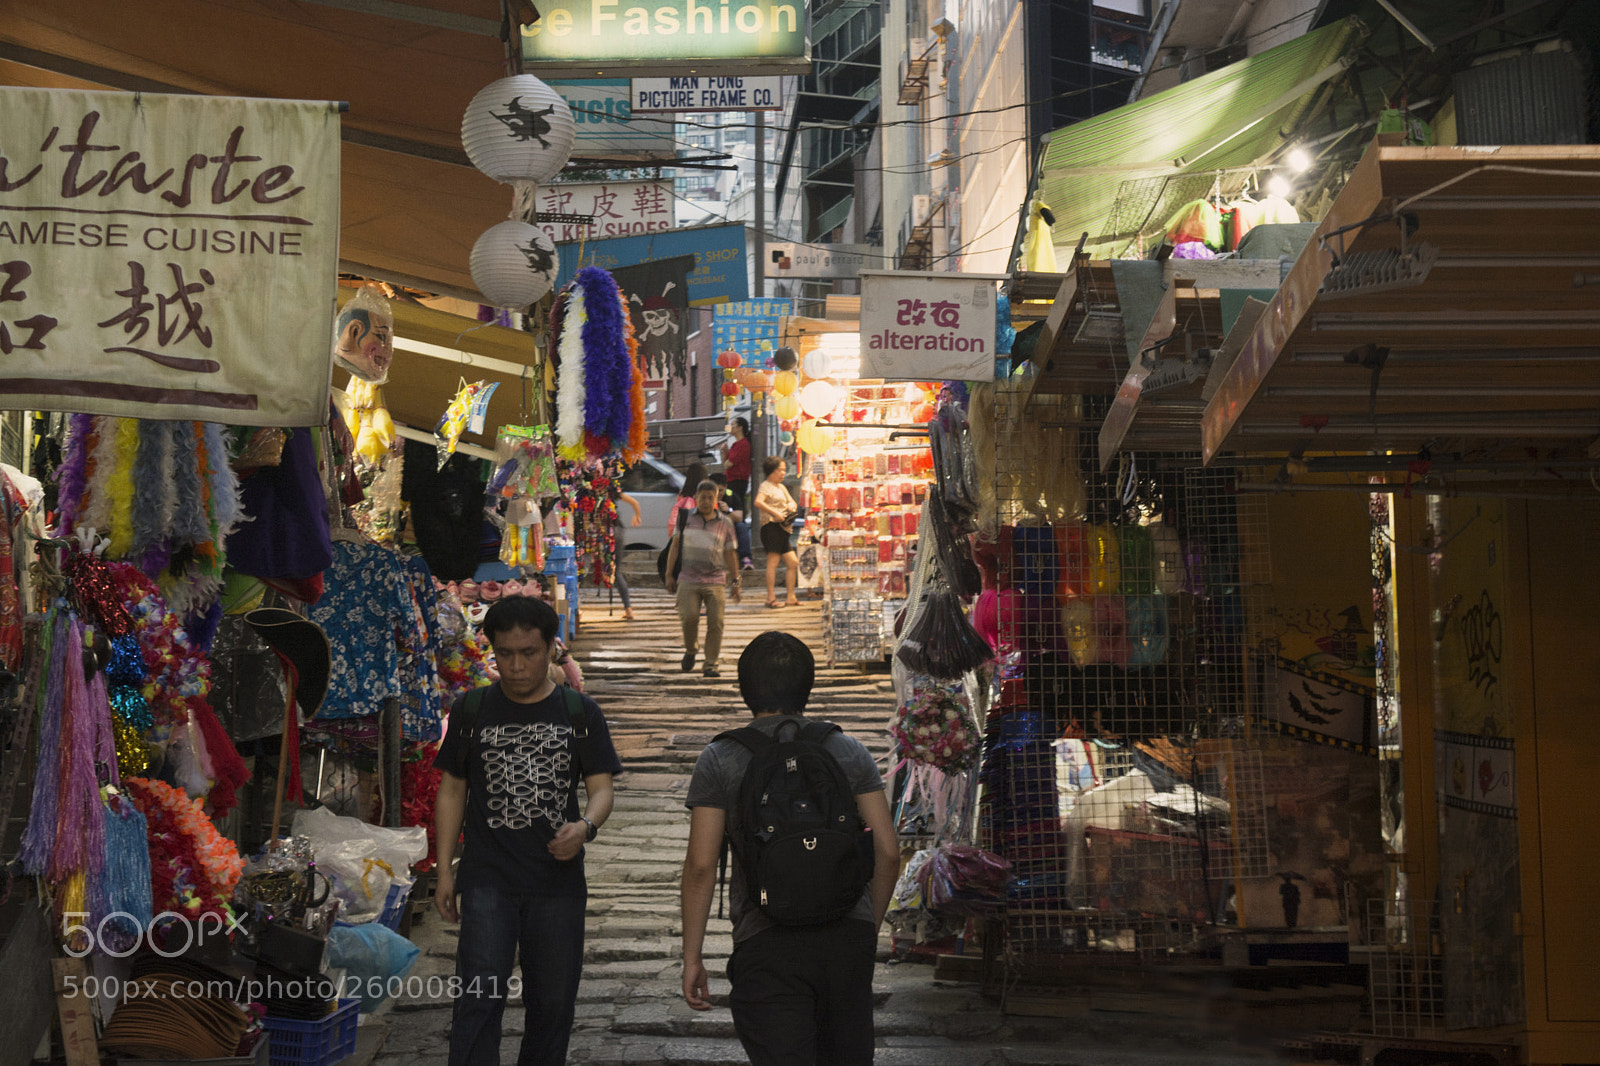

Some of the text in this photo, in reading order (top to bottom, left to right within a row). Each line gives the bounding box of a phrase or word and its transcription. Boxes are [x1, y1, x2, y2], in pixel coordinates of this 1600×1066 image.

[591, 0, 798, 36] Fashion
[670, 77, 743, 89] MAN FUNG
[639, 88, 774, 108] PICTURE FRAME CO.
[560, 95, 632, 124] ucts
[542, 184, 669, 219] 記皮鞋
[0, 221, 304, 256] AMESE CUISINE
[562, 223, 597, 241] KEE
[605, 220, 670, 237] SHOES
[705, 248, 739, 262] SHOP
[796, 254, 820, 266] paul
[868, 329, 985, 353] alteration
